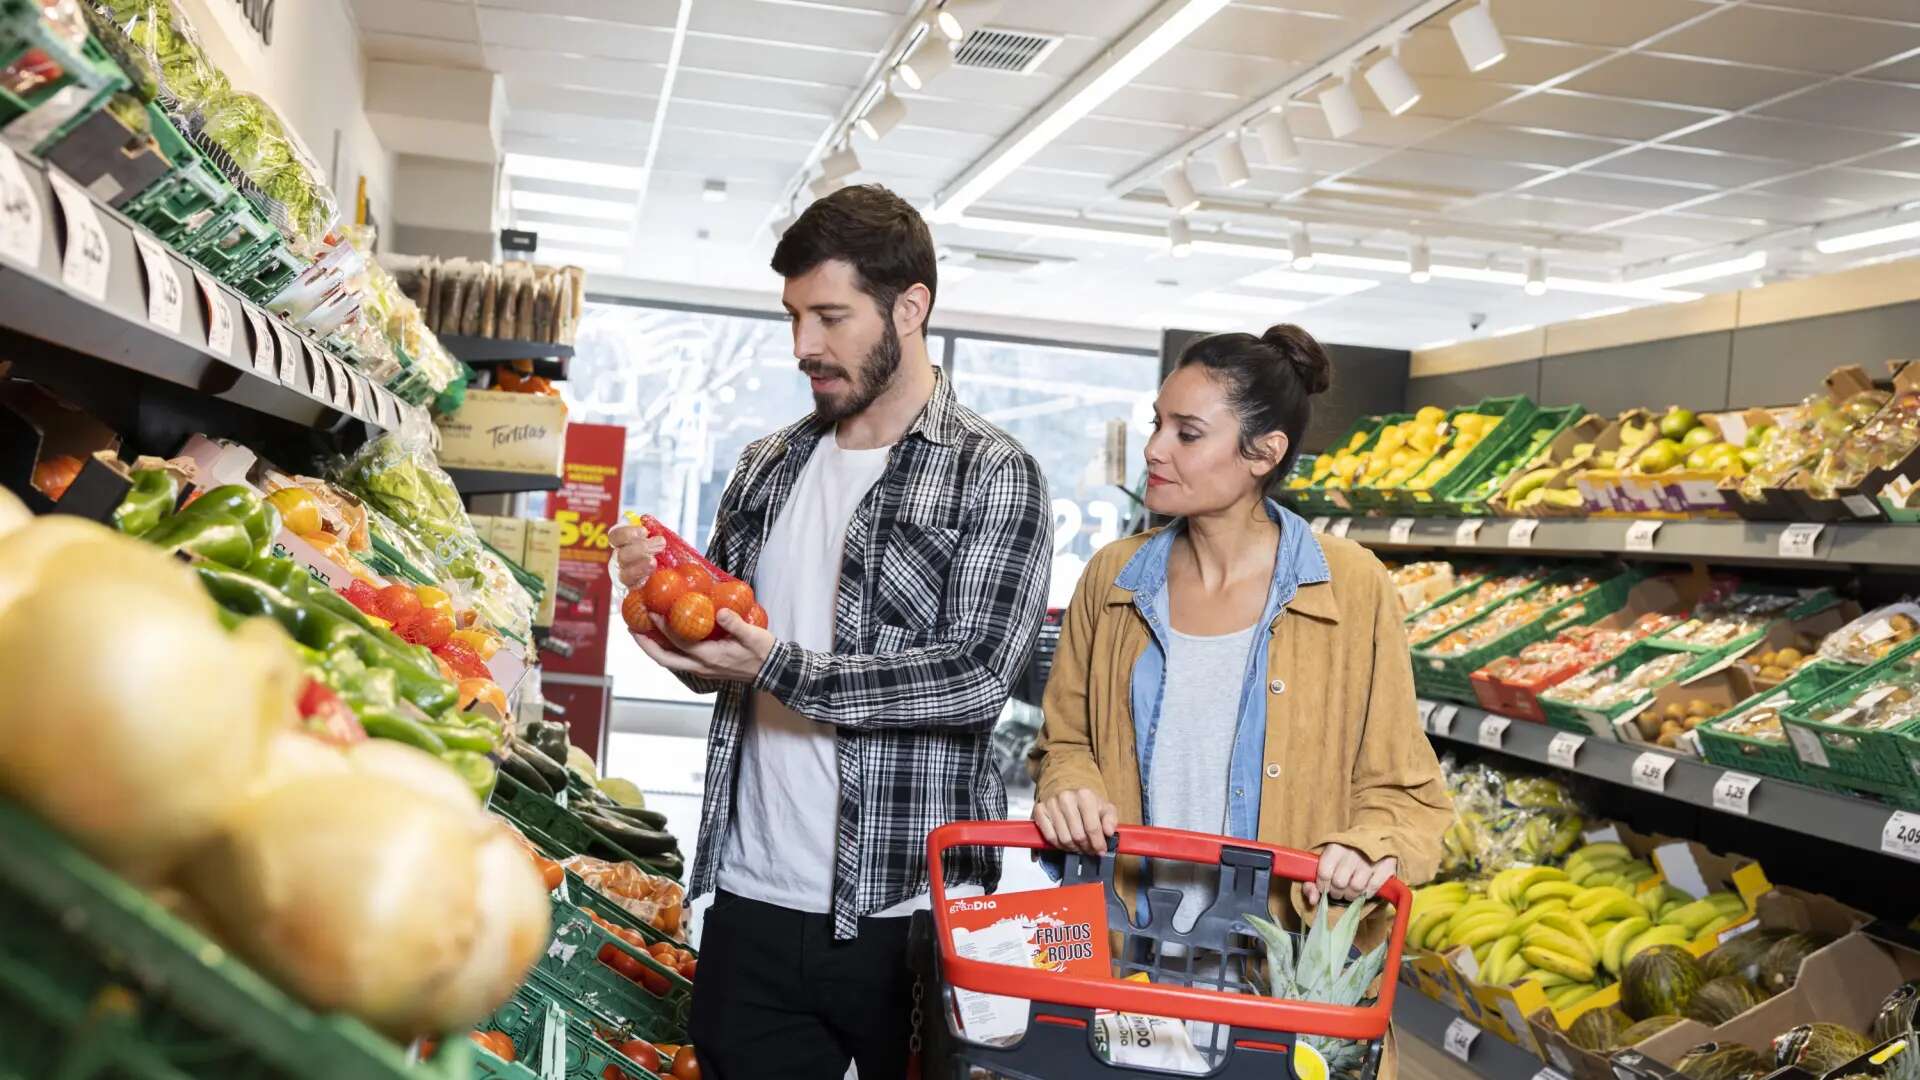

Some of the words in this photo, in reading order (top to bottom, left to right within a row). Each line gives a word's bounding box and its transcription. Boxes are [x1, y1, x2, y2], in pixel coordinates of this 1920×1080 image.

[555, 510, 608, 550] 5%
[1036, 923, 1091, 945] FRUTOS
[1049, 942, 1093, 962] ROJOS
